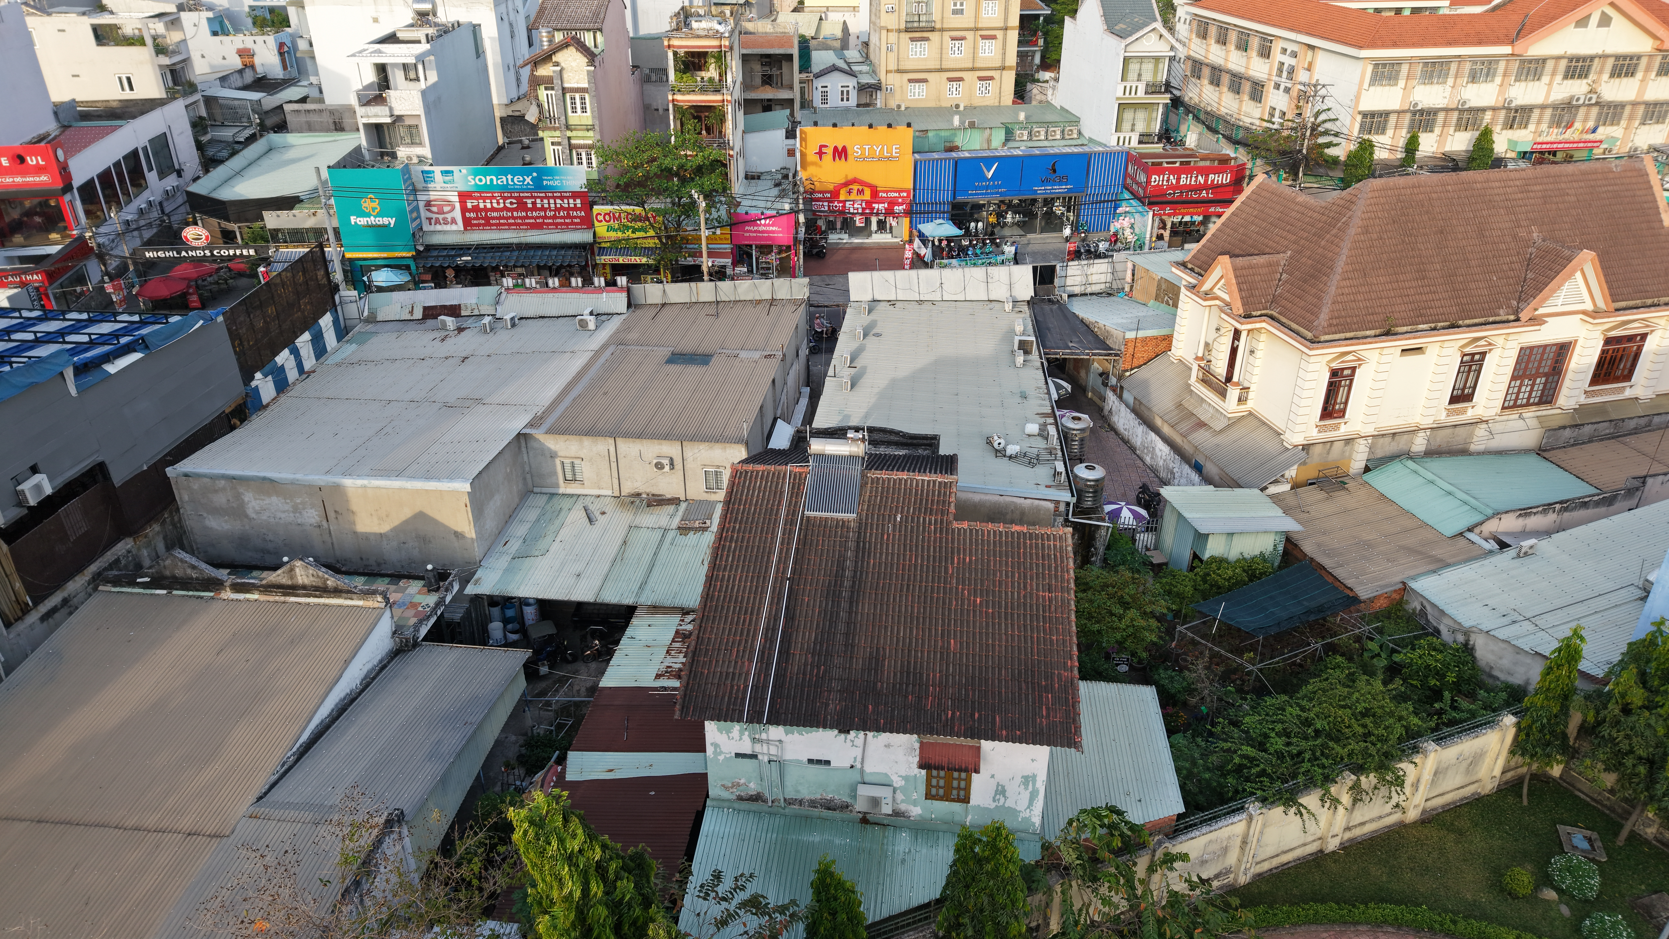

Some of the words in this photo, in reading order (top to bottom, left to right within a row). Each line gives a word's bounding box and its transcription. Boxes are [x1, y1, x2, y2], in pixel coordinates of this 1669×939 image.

[812, 144, 848, 162] FM
[853, 145, 900, 156] STYLE
[467, 174, 533, 185] sonatex
[1151, 171, 1177, 188] ĐIỆN
[1180, 171, 1205, 184] BIÊN
[1208, 170, 1231, 184] PHỦ
[846, 188, 865, 196] FM
[1166, 190, 1214, 198] OPTICAL
[466, 197, 518, 209] PHÚC
[523, 199, 582, 210] THỊNH
[350, 216, 395, 227] Fantasy
[426, 217, 458, 225] TASA
[595, 211, 622, 223] CƠM
[145, 250, 211, 258] HIGHLANDS
